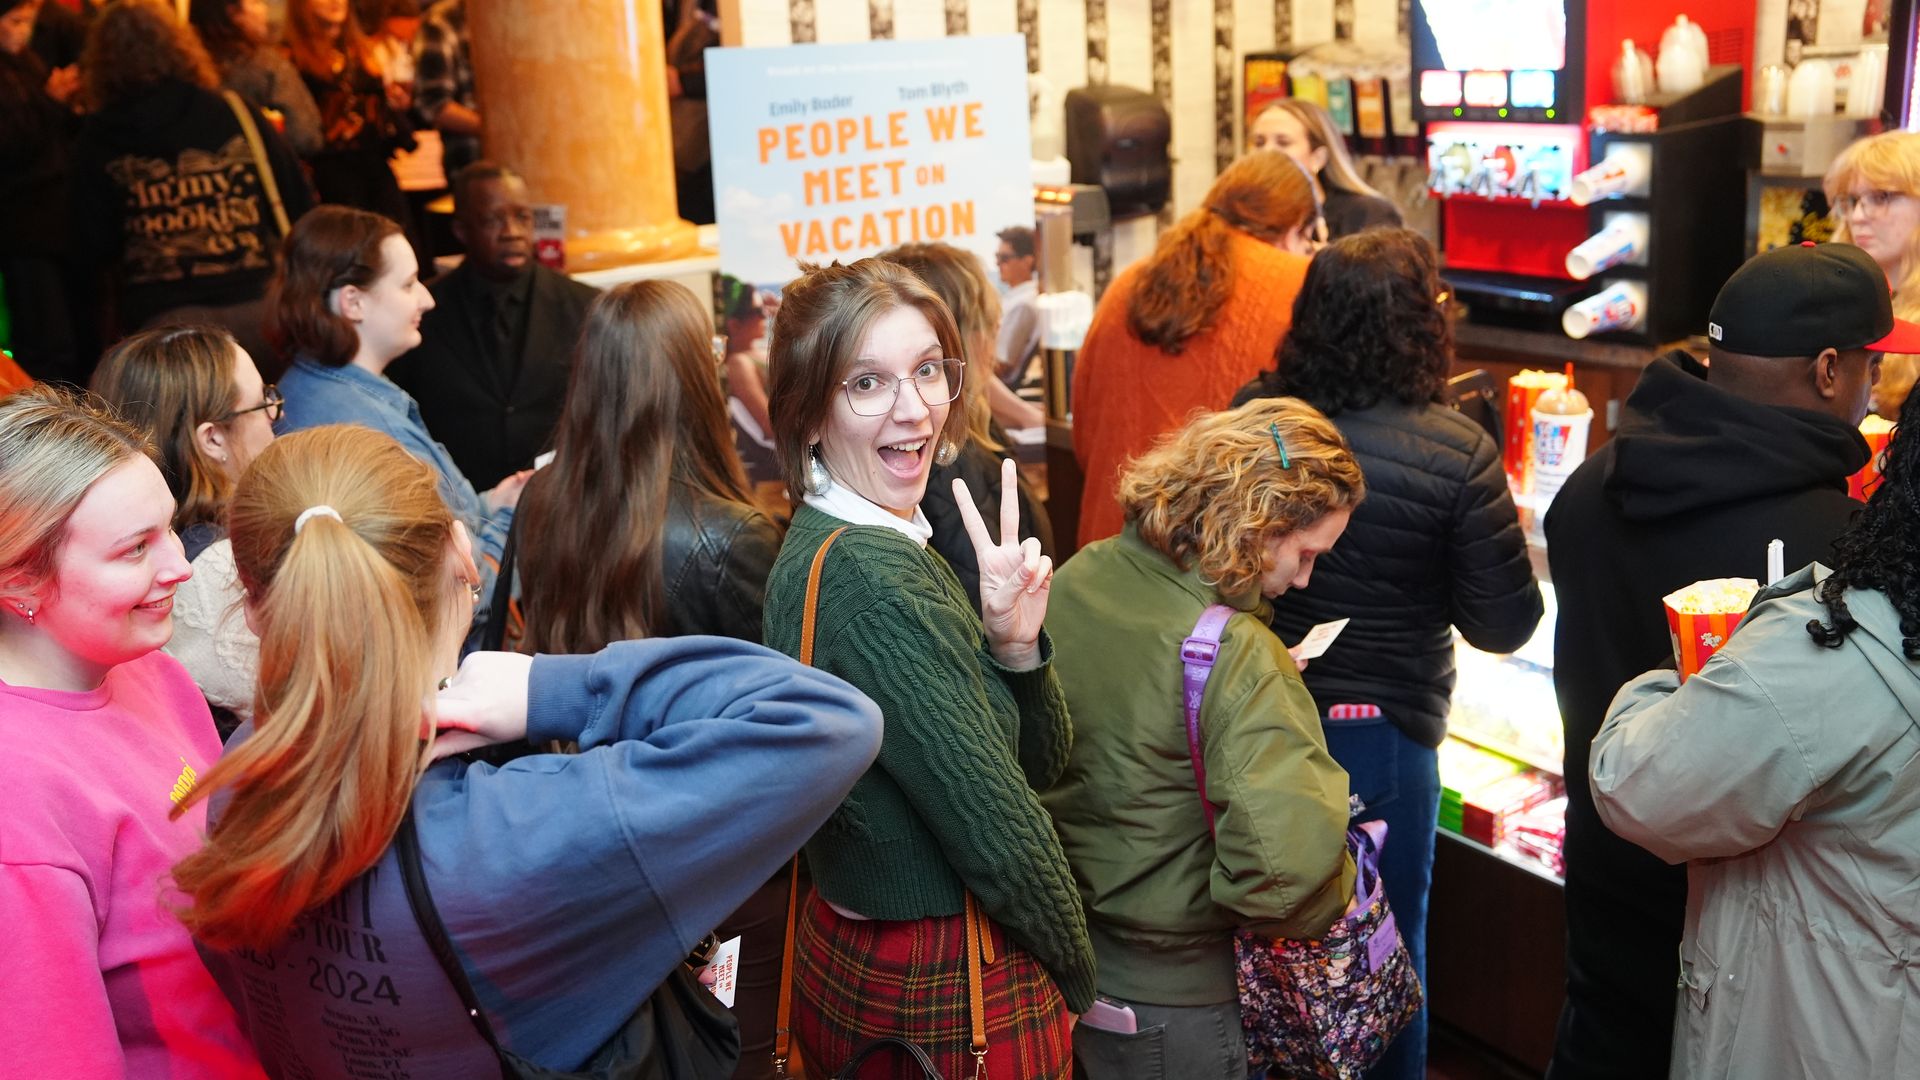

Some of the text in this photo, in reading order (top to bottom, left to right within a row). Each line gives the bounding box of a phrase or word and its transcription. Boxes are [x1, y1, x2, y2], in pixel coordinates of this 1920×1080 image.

[769, 99, 808, 118] Emily
[757, 102, 985, 165] PEOPLE WE
[803, 159, 946, 207] MEET ON
[779, 200, 976, 258] VACATION
[311, 916, 388, 963] TOUR
[307, 955, 402, 1006] 2024
